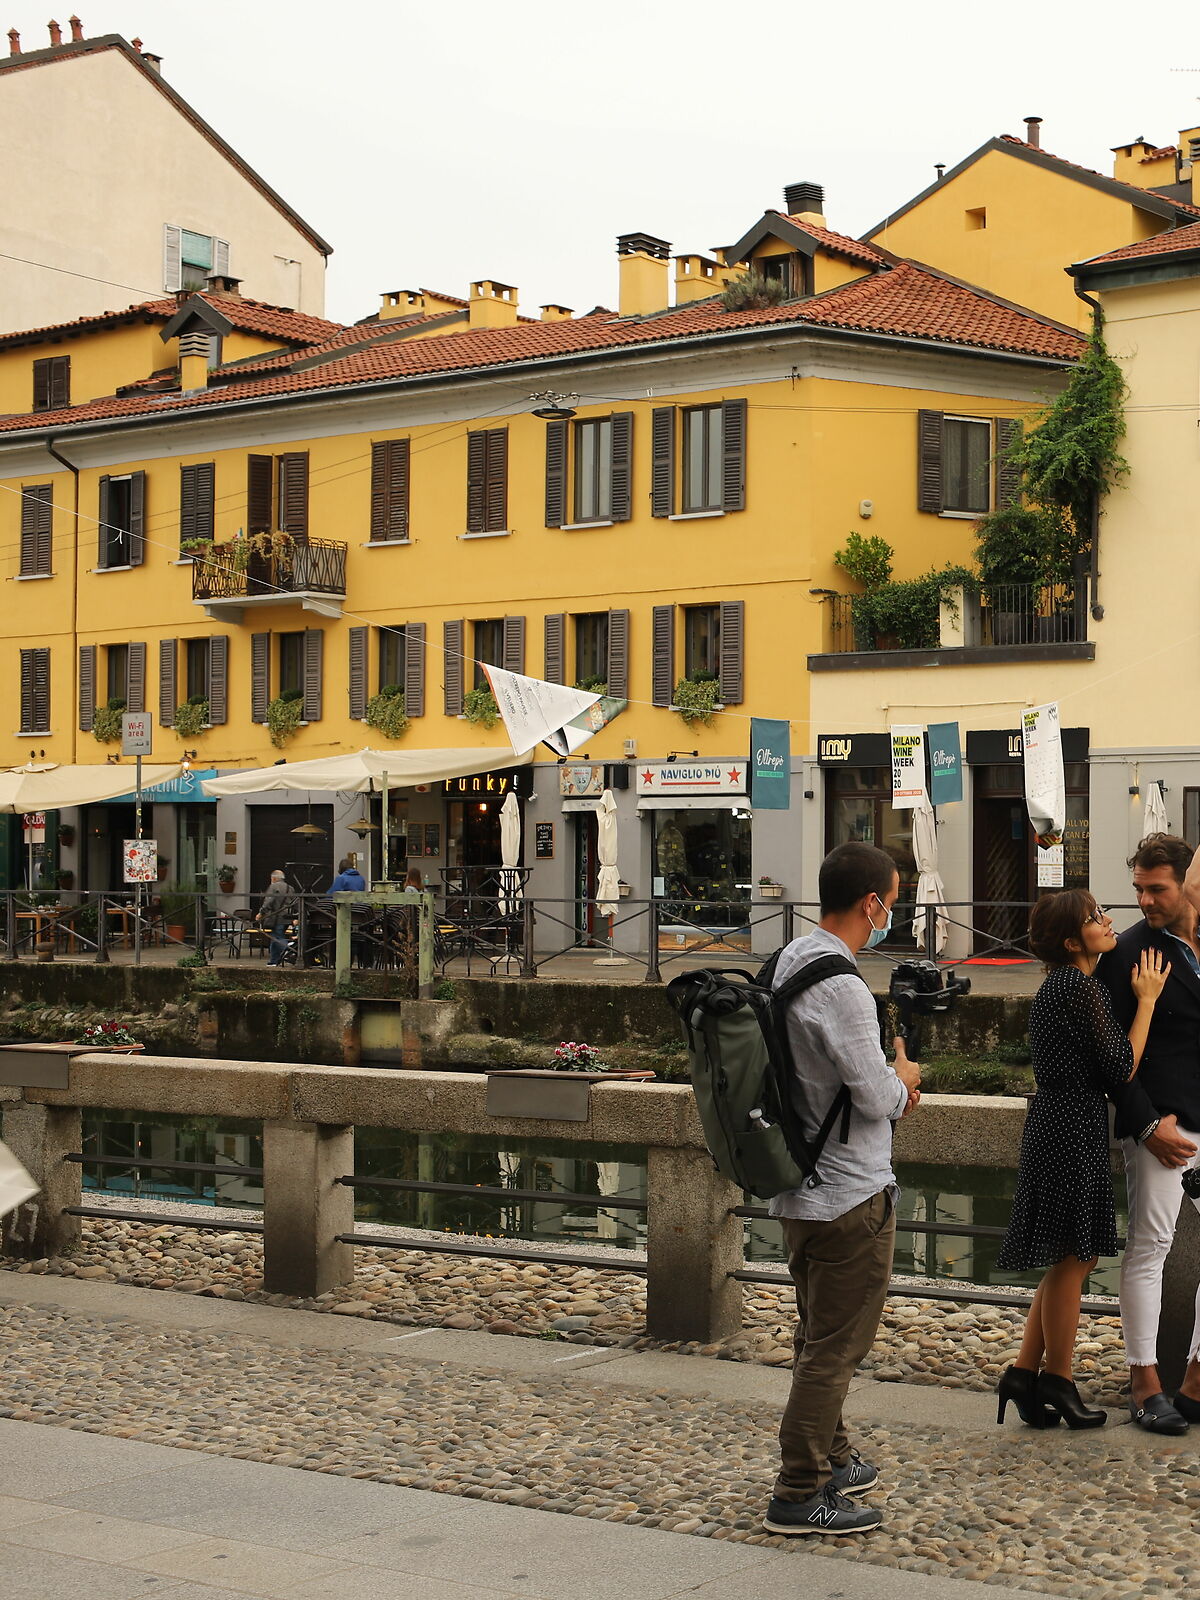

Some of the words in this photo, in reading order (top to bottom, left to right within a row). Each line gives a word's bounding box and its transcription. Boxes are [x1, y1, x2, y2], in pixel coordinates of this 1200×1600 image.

[128, 721, 145, 729] Wi-Fi
[893, 737, 921, 746] MILANO
[893, 748, 912, 756] WINE
[893, 758, 914, 767] WEEK
[661, 769, 703, 779] NAVIGLIO
[894, 769, 901, 778] 20
[894, 780, 901, 788] 20
[807, 1504, 838, 1528] N
